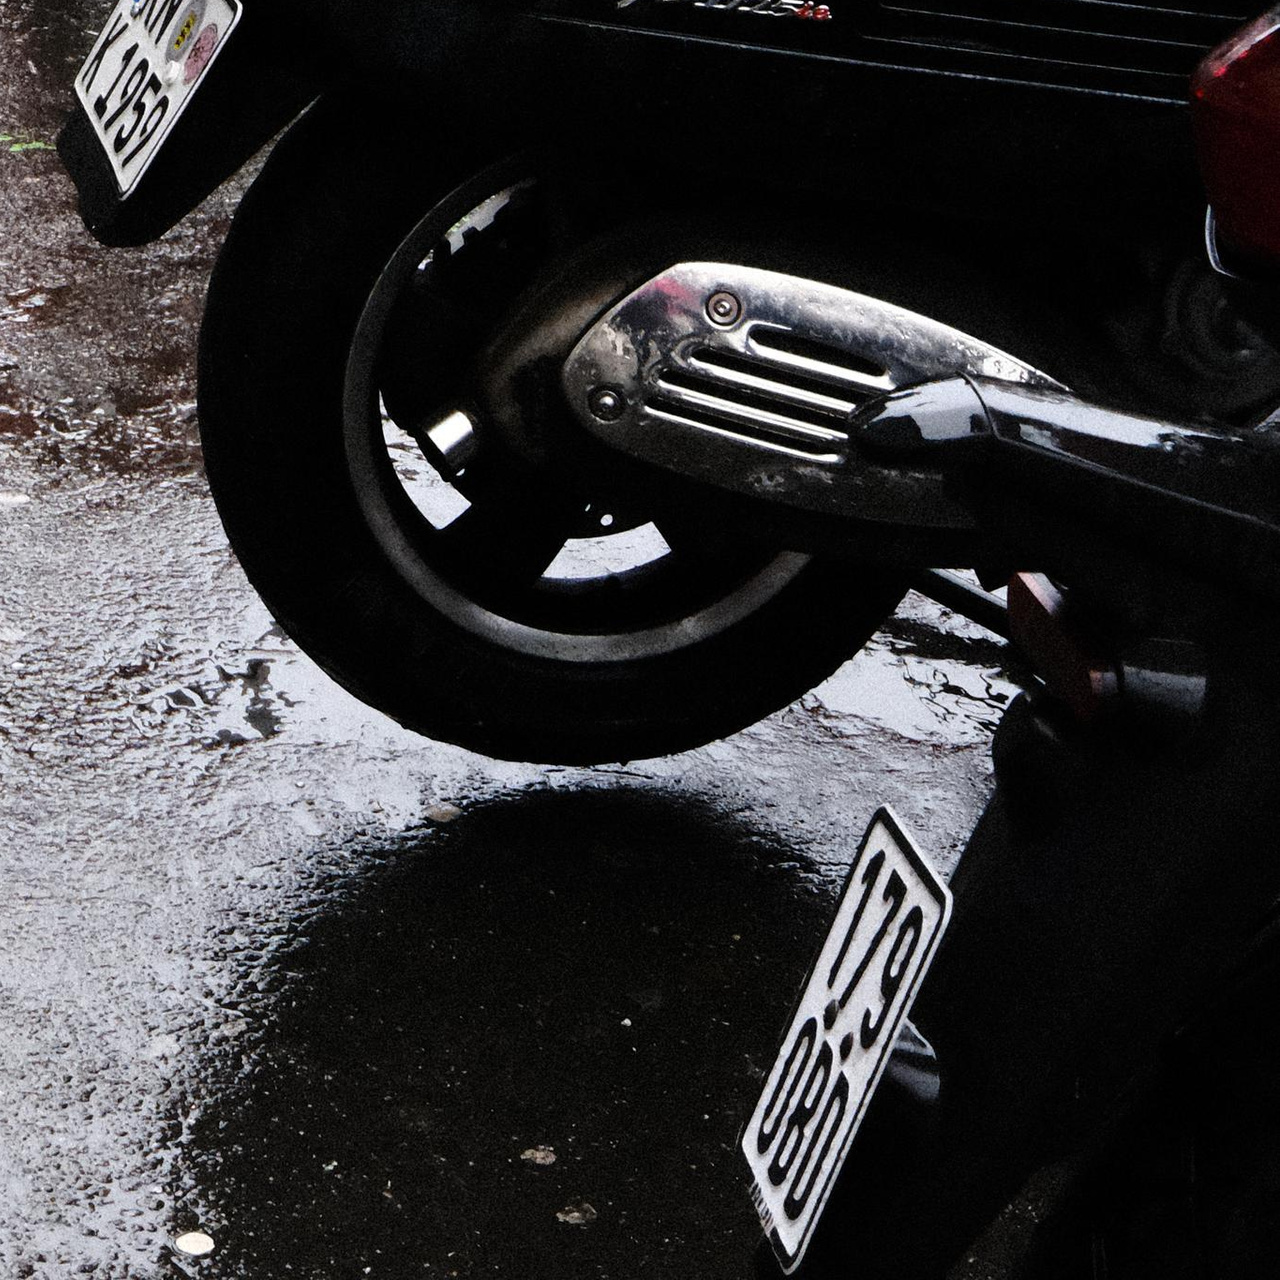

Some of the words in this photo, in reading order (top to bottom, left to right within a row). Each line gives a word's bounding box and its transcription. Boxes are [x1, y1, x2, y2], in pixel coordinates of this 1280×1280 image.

[81, 12, 130, 94] K
[94, 43, 170, 169] 1959
[827, 849, 924, 1050] 179
